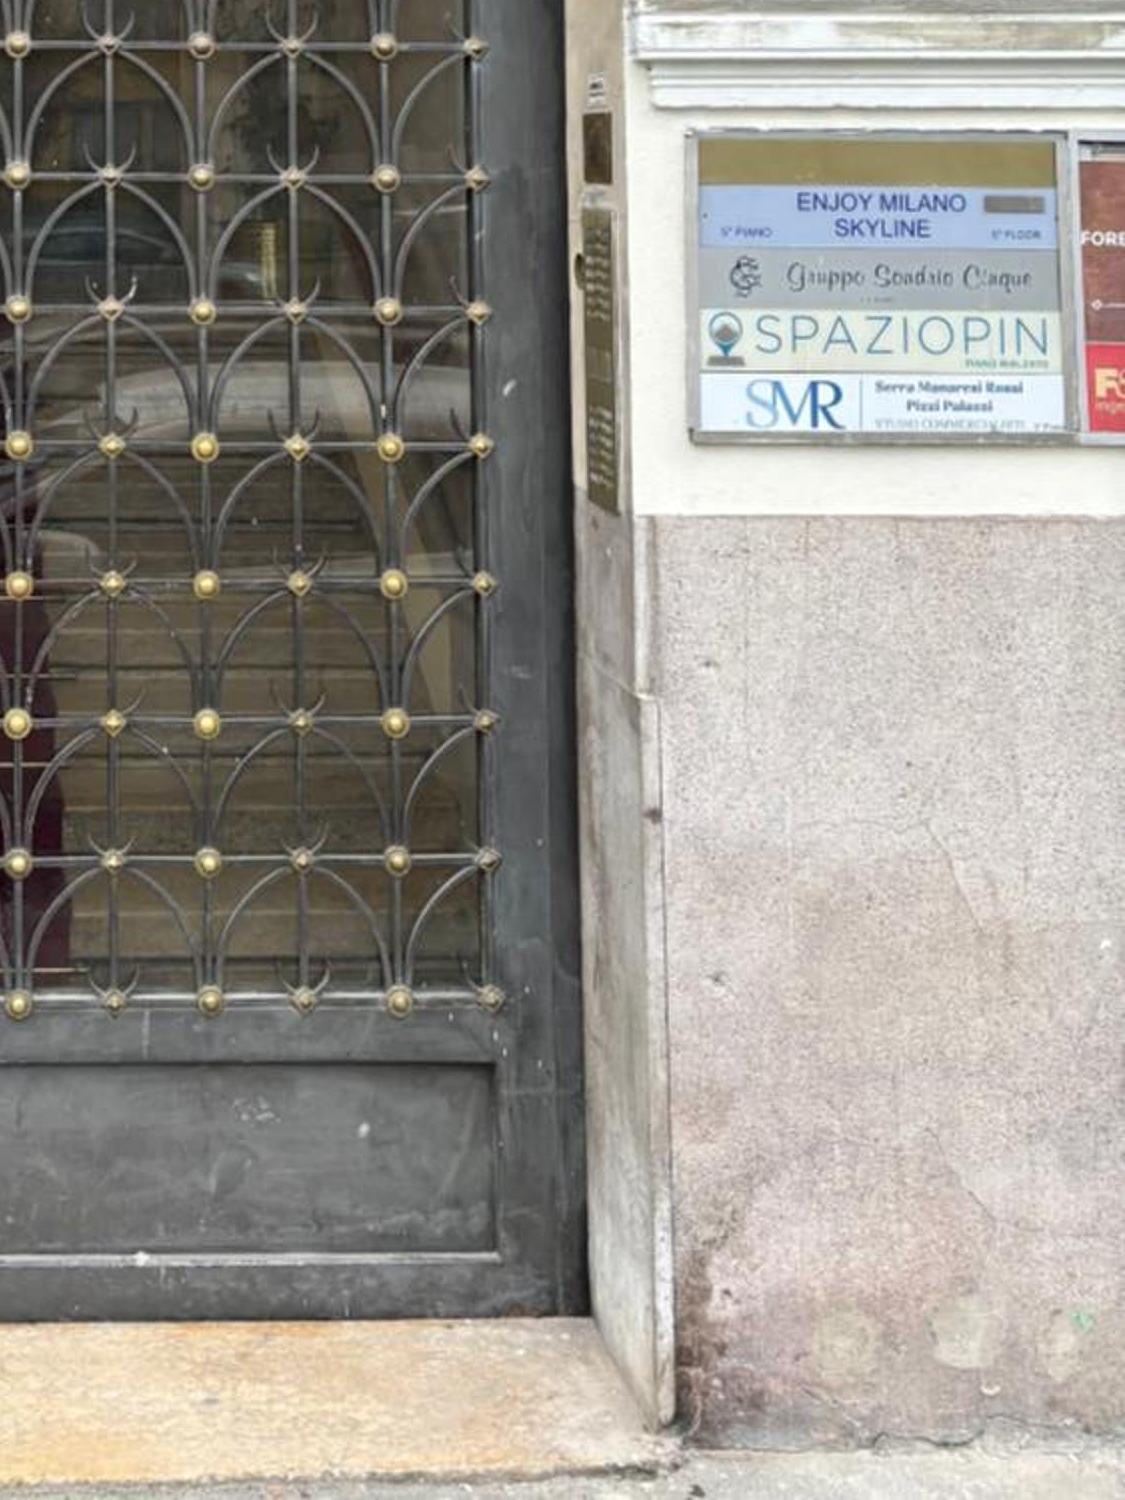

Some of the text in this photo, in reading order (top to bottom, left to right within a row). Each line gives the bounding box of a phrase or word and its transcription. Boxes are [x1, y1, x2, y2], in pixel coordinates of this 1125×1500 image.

[796, 191, 967, 213] ENJOY MILANO
[834, 218, 931, 239] SKYLINE
[786, 261, 865, 293] Gruppo
[755, 315, 1048, 356] SPAZIOPIN
[745, 378, 846, 430] SMR
